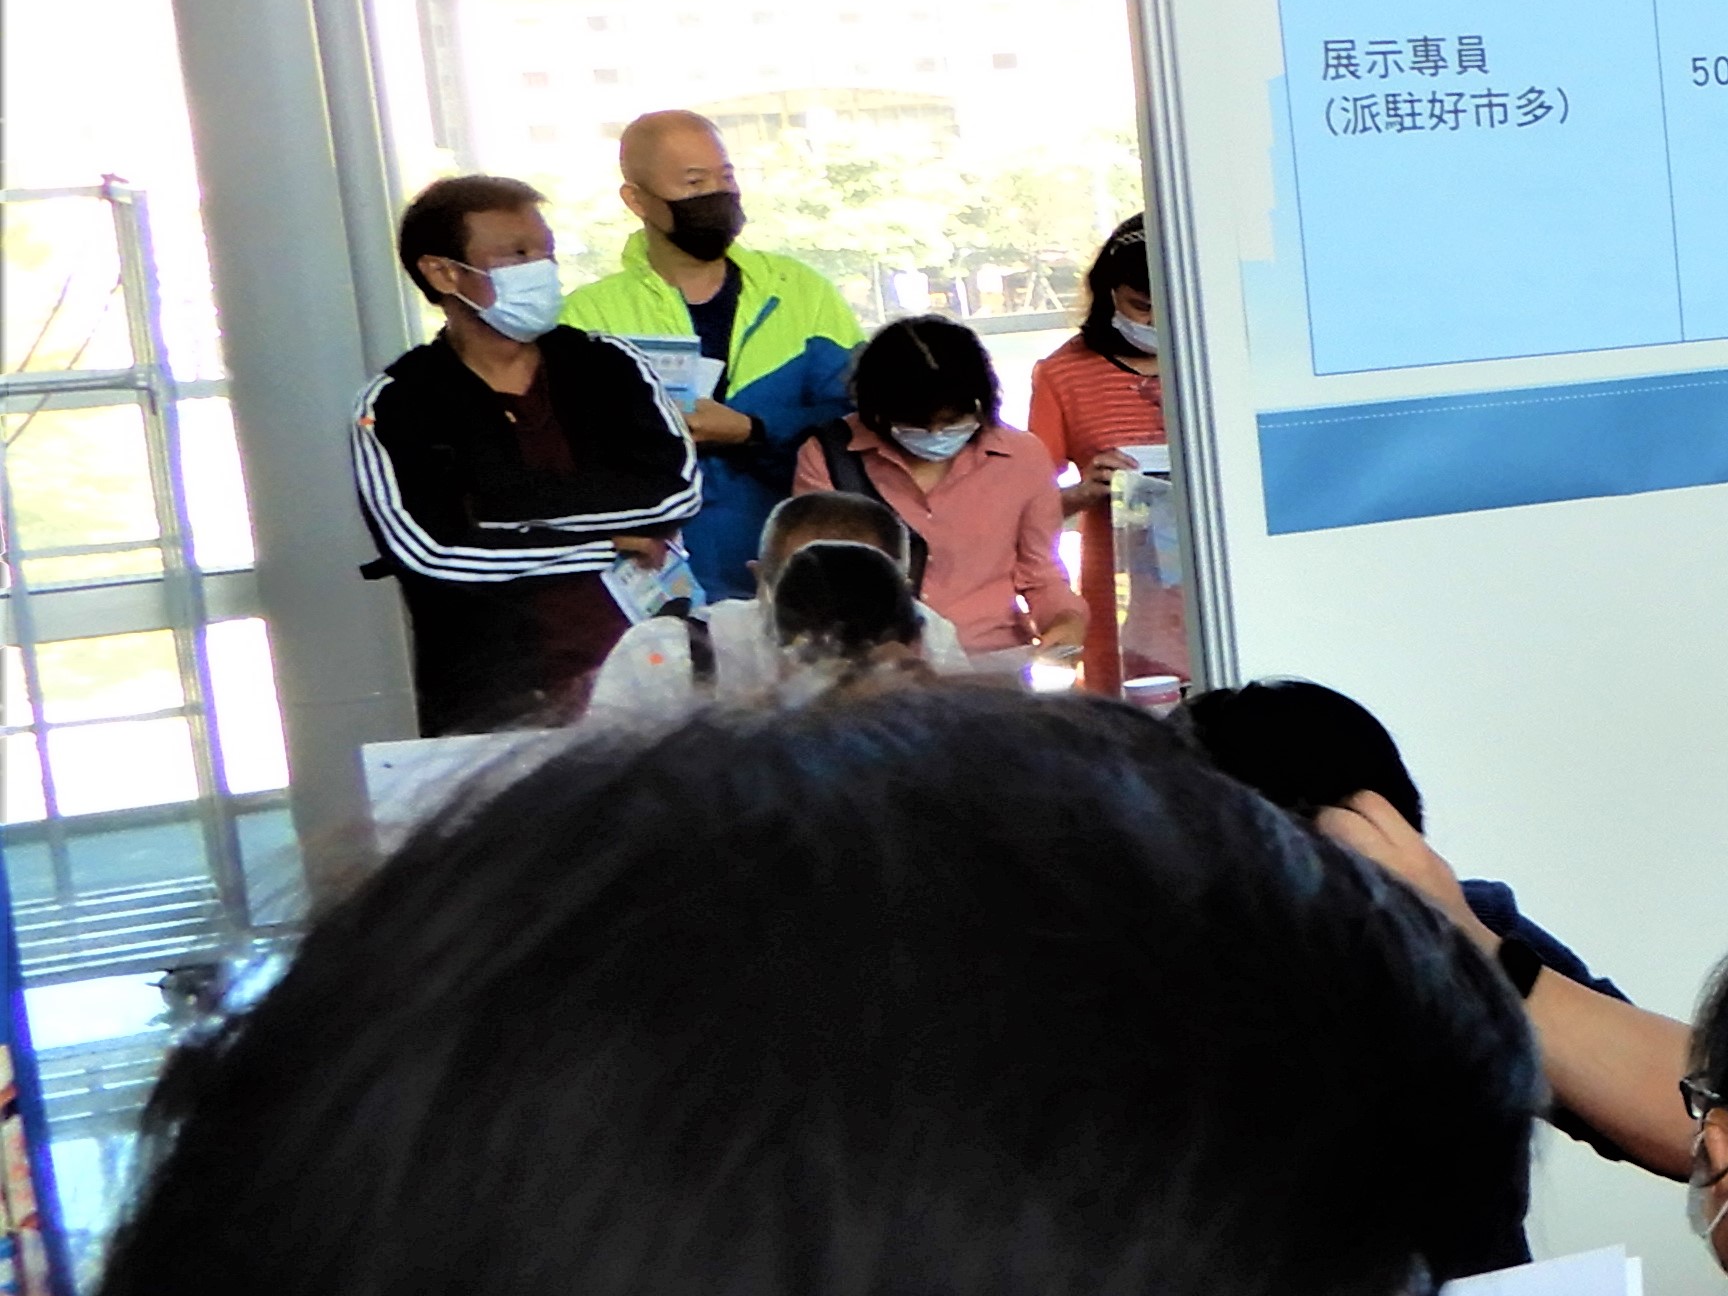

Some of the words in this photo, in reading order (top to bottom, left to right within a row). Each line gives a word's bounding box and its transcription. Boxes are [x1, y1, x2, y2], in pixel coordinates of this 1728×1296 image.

[1320, 35, 1490, 81] 展示專員
[1322, 85, 1571, 138] (派駐好市多)
